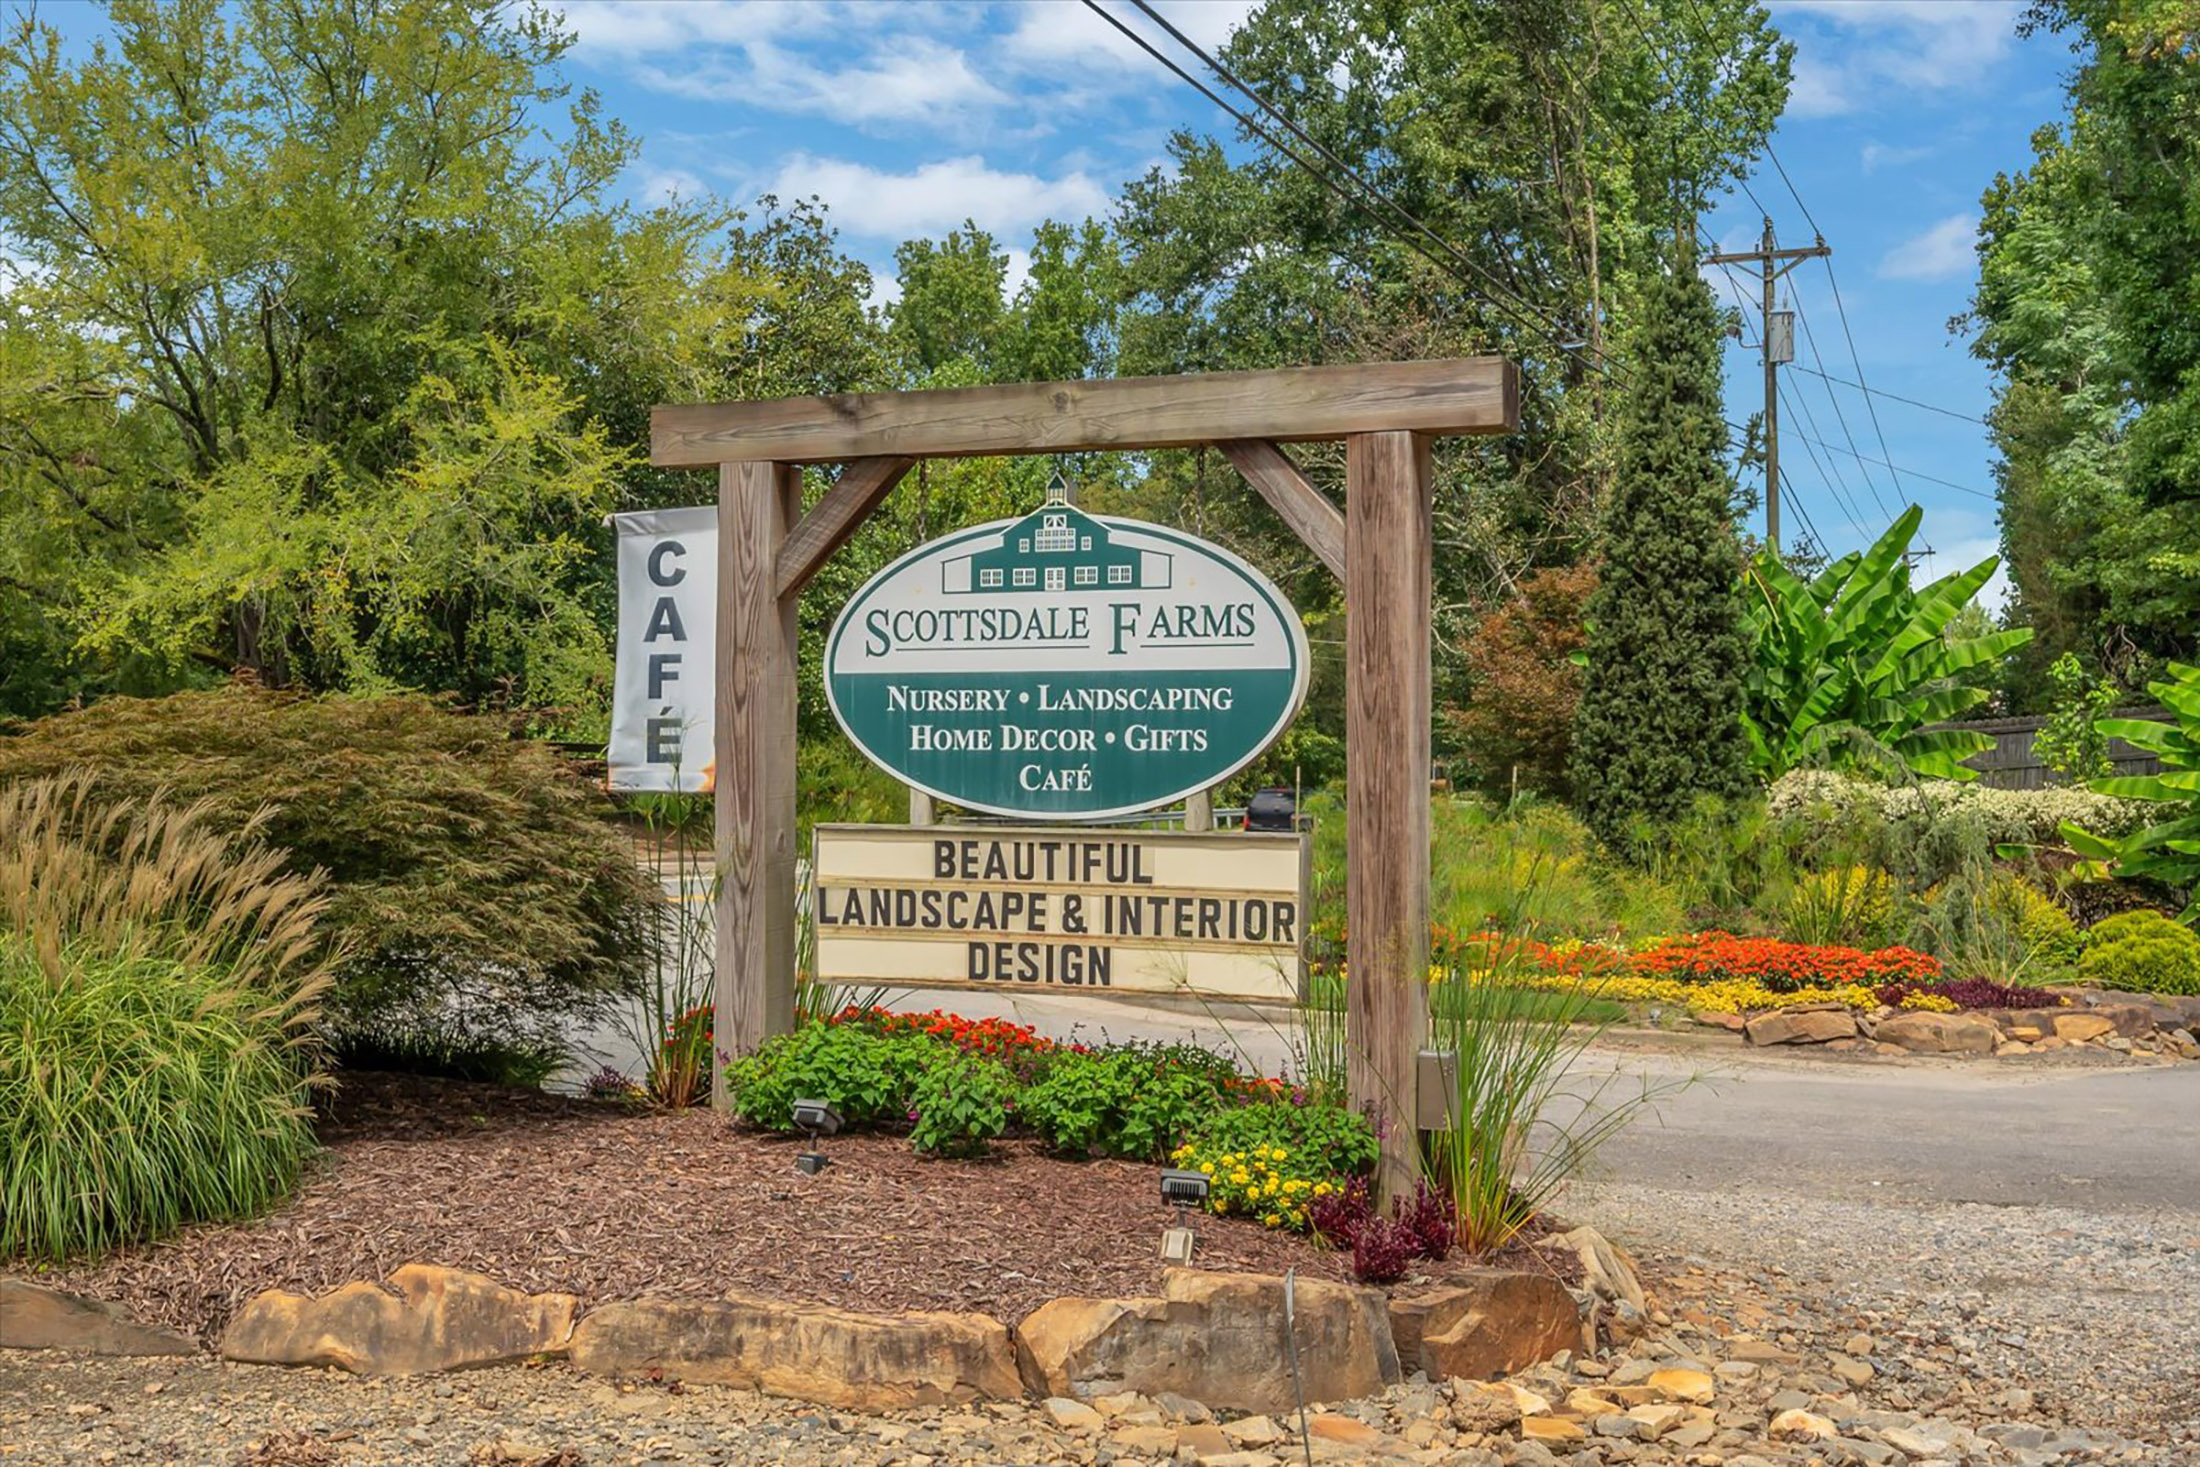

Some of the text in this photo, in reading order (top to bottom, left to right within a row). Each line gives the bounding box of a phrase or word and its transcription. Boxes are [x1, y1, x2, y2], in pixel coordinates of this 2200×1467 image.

[643, 540, 688, 764] CAFÉ
[865, 602, 1256, 658] SCOTTSDALE FARMS
[886, 684, 1234, 712] NURSERY LANDSCAPING
[909, 723, 1208, 752] HOME DECOR GIFTS
[1018, 762, 1093, 792] CAFÉ
[934, 839, 1153, 884] BEAUTIFUL
[818, 886, 1295, 943] LANDSCAPE & INTERIOR
[967, 941, 1112, 987] DESIGN
